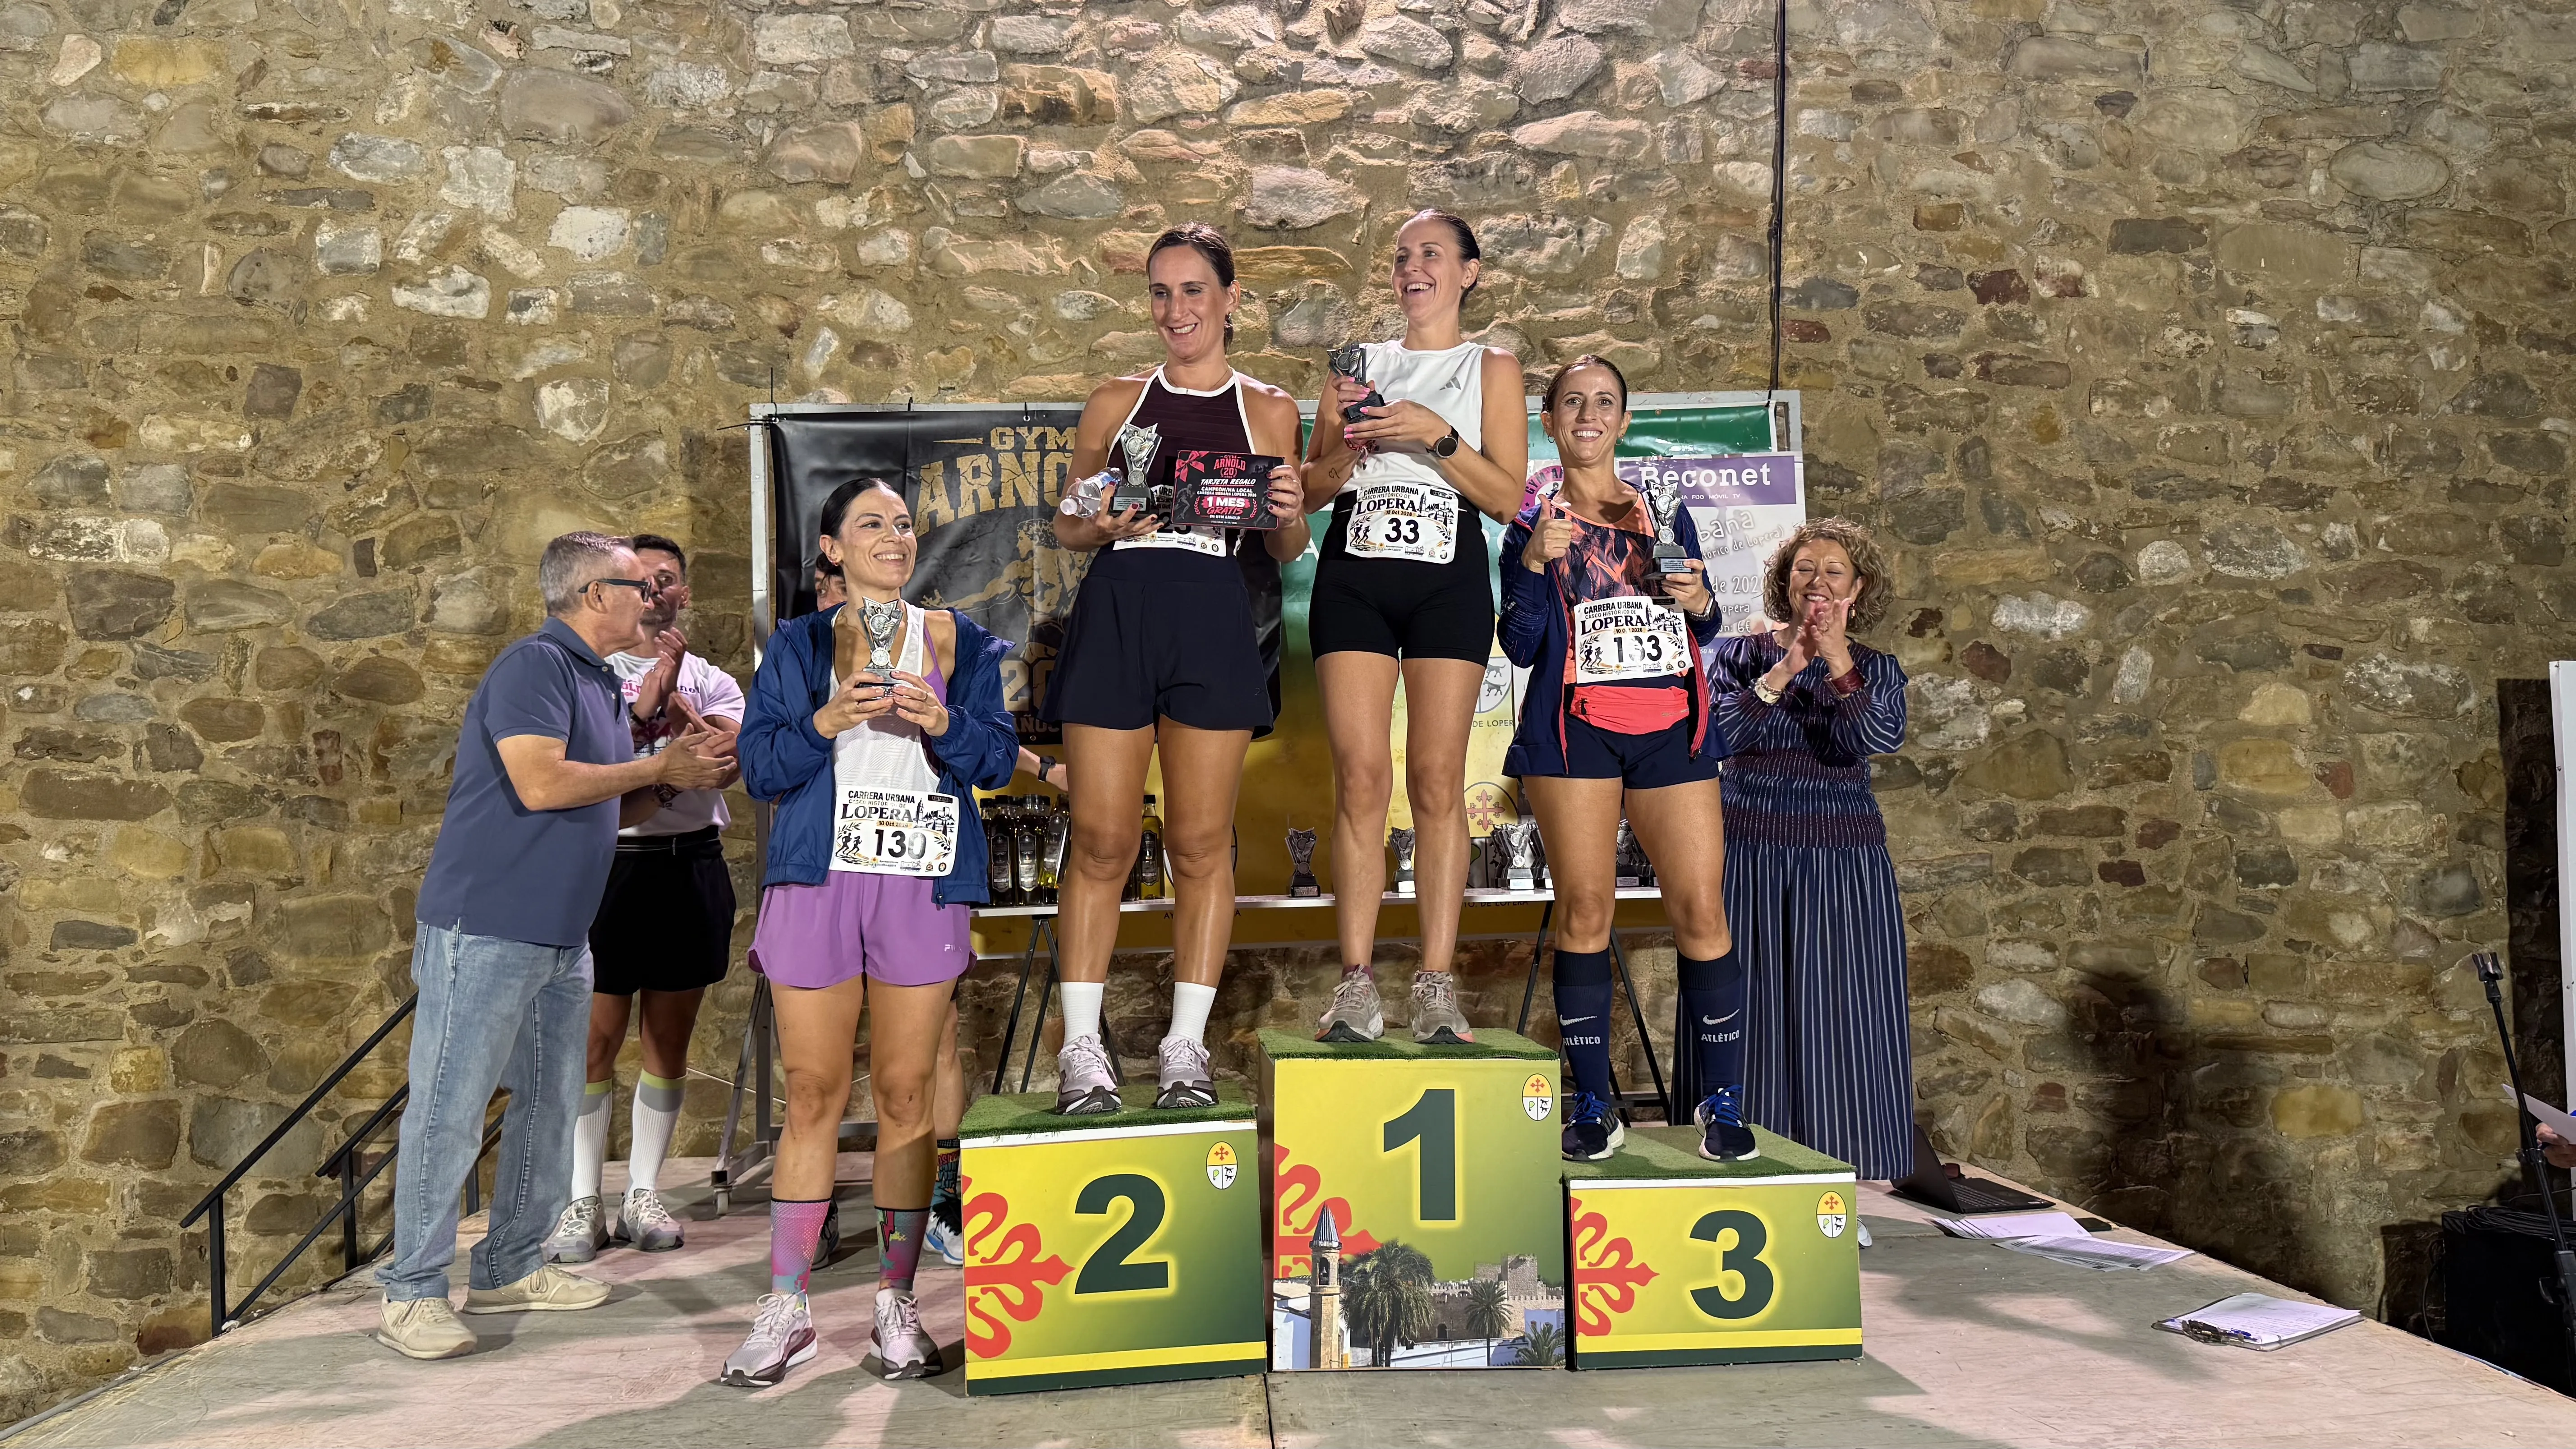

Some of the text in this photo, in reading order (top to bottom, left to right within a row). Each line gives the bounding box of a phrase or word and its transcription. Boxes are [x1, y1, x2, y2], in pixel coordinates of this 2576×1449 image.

[990, 427, 1077, 450] GYM
[1214, 458, 1246, 471] ARNOLD
[1224, 467, 1234, 475] 20
[915, 451, 1074, 538] ARNO
[1364, 486, 1390, 496] CARRERA
[1392, 485, 1419, 495] URBANA
[1206, 497, 1245, 507] 1 MES
[1207, 507, 1243, 515] GRATIS
[1356, 498, 1417, 515] LOPERA
[1385, 518, 1419, 544] 33
[1694, 510, 1755, 542] bana
[1702, 545, 1729, 560] tórico
[1733, 541, 1743, 551] de
[1712, 576, 1726, 593] de
[1584, 602, 1616, 614] CARRERA
[1617, 601, 1643, 610] URBANA
[1722, 604, 1750, 616] opera
[1580, 615, 1646, 635] LOPERA
[848, 791, 915, 804] CARRERA URBANA
[841, 804, 914, 823] LOPERA
[875, 829, 927, 860] 130
[1383, 1090, 1456, 1220] 1
[1075, 1173, 1168, 1294] 2
[1689, 1210, 1774, 1319] 3
